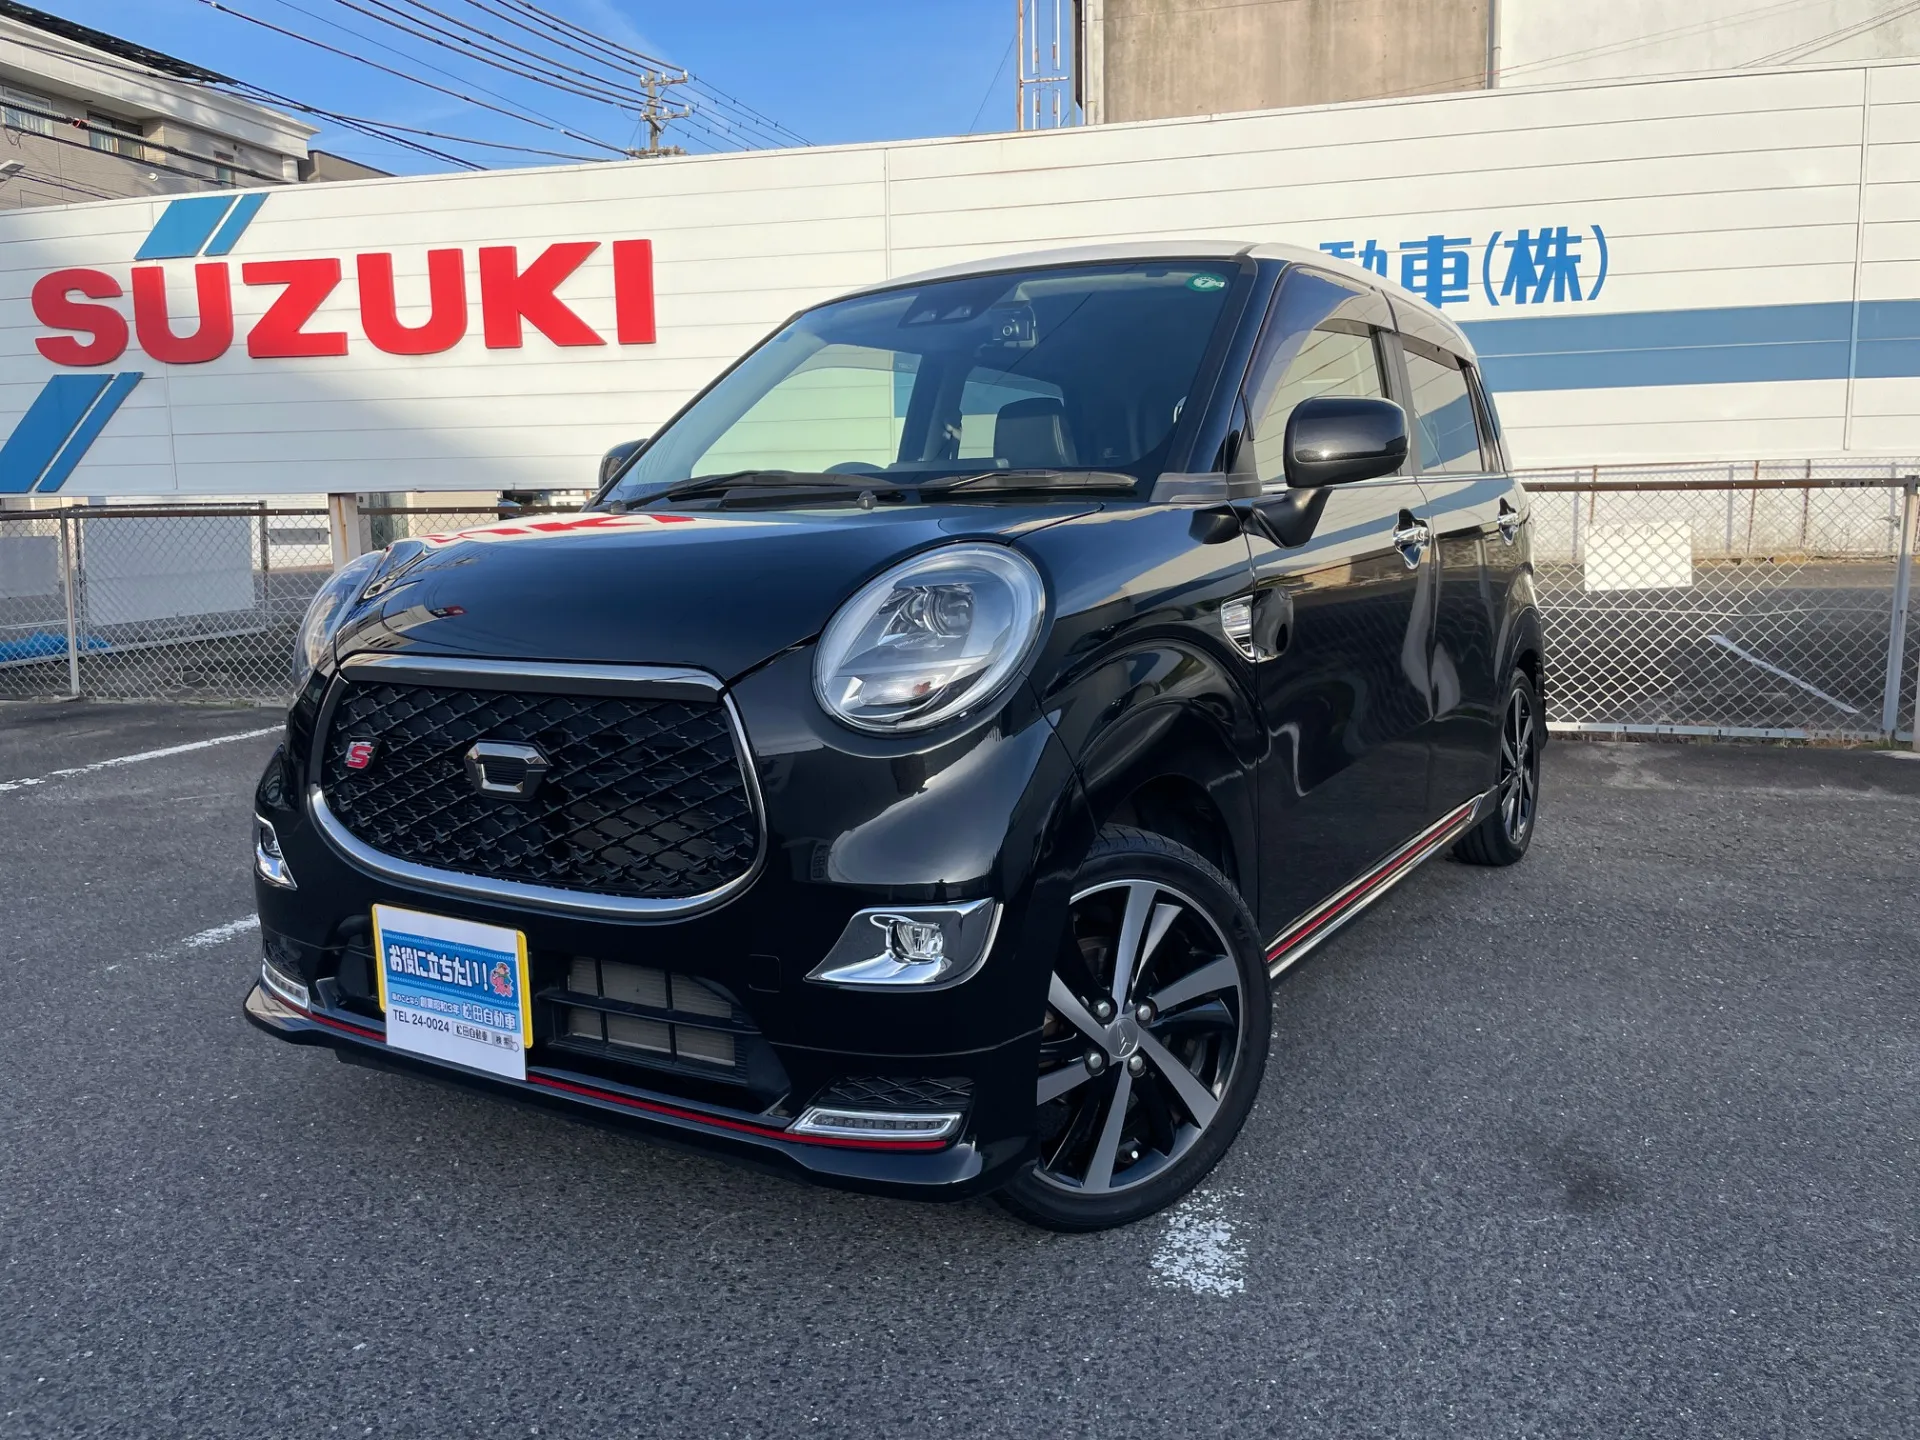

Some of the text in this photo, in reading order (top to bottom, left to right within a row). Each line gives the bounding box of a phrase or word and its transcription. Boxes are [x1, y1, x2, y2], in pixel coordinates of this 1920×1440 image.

[31, 239, 656, 366] SUZUKI
[346, 743, 374, 769] S
[389, 944, 488, 991] お役に立ちたい!
[393, 1009, 449, 1032] TEL 24-0024
[462, 1002, 516, 1030] 松田自動車
